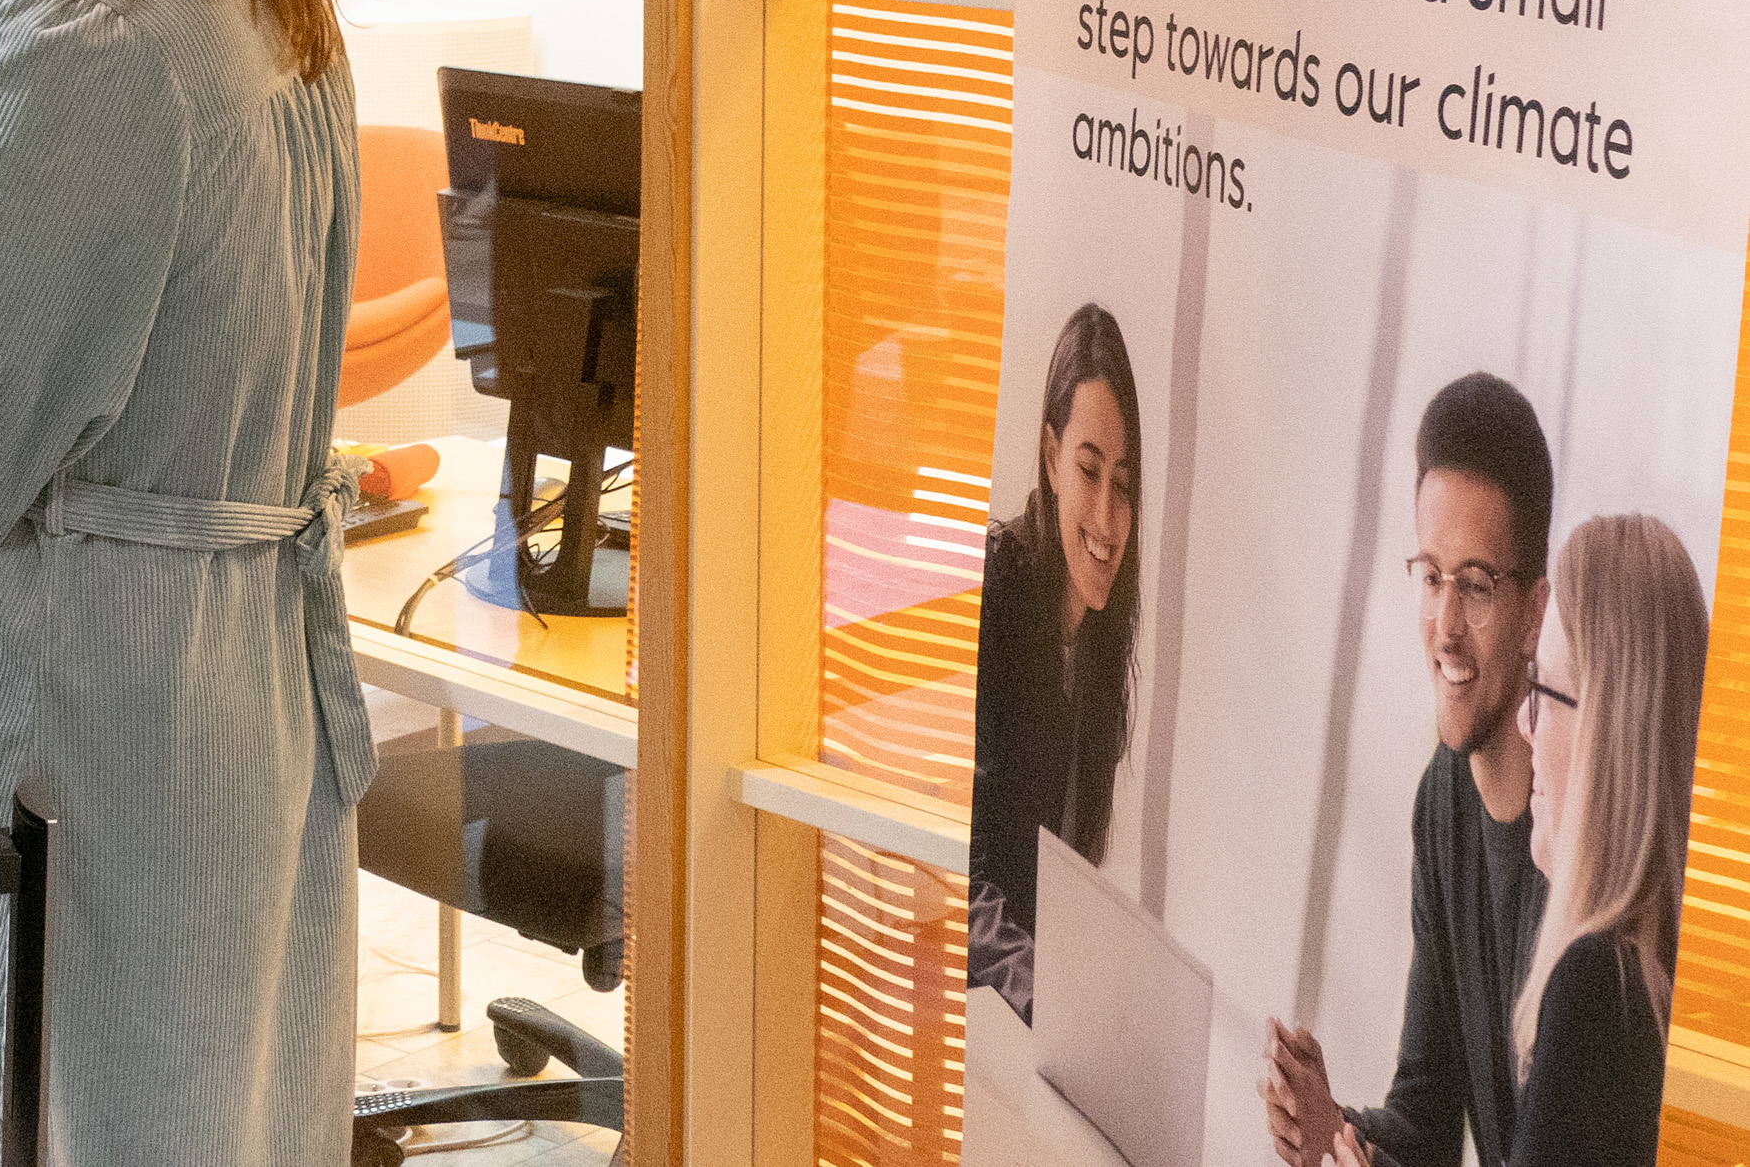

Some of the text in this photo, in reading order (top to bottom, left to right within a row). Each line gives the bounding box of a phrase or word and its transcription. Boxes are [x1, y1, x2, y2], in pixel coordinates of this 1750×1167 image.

[1071, 107, 1254, 213] ambitions.
[1165, 12, 1322, 109] towards
[1334, 61, 1422, 128] our
[1437, 64, 1635, 181] climate
